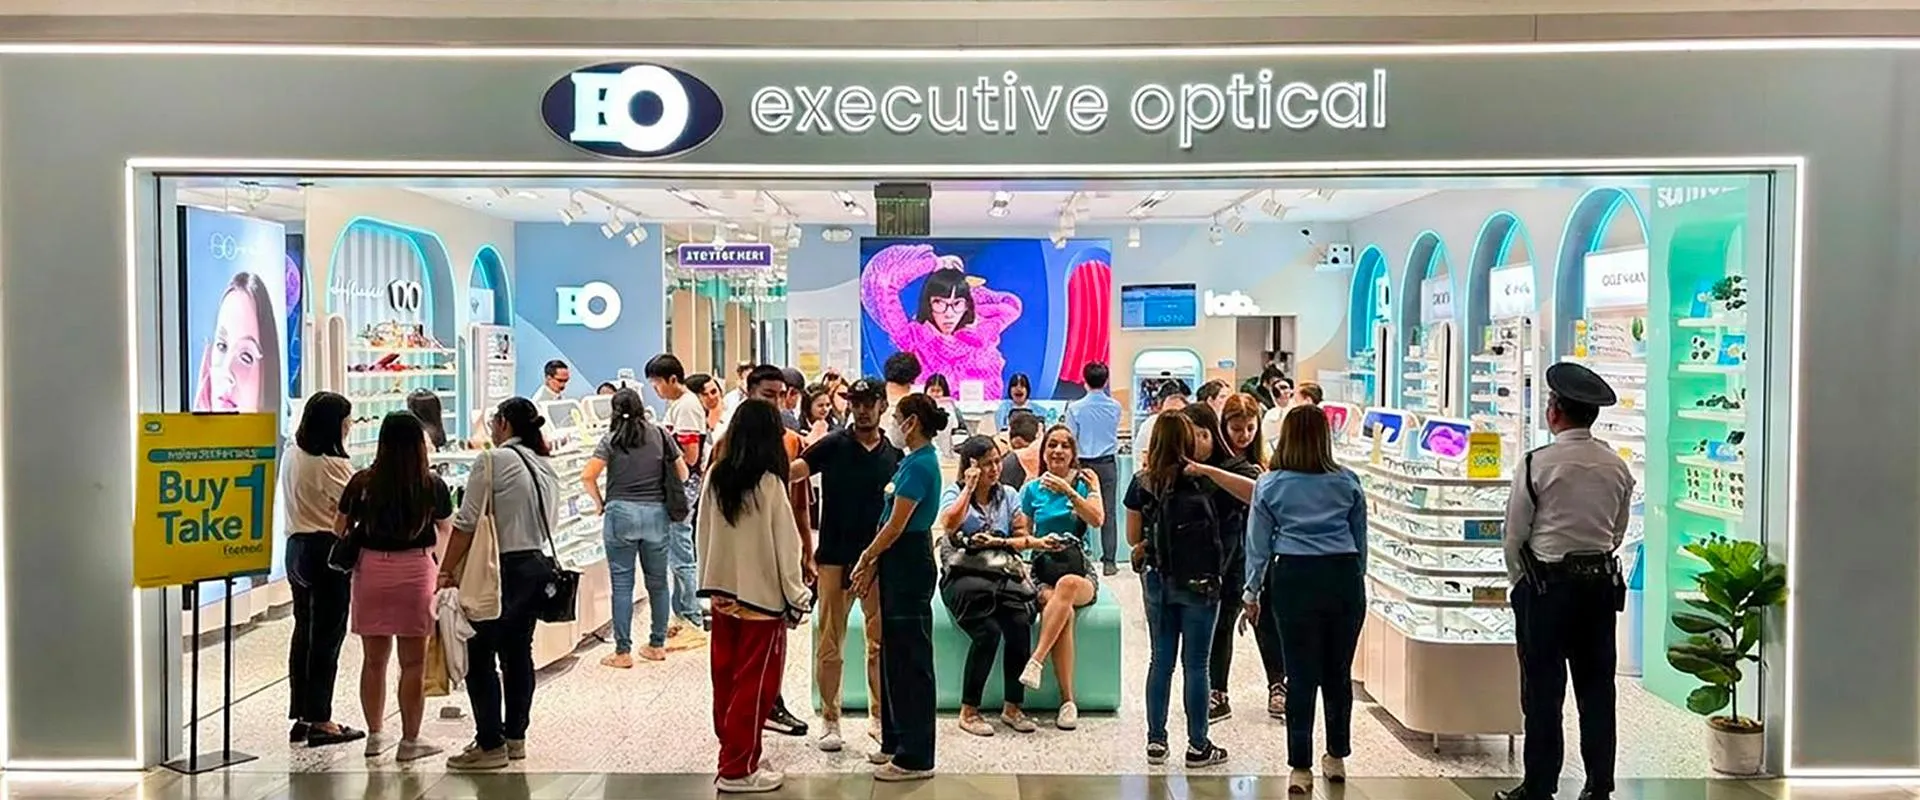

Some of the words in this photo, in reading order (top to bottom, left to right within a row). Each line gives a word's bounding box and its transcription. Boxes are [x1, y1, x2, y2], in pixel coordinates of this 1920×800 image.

[569, 65, 689, 152] EO
[751, 71, 1109, 133] executive
[1131, 69, 1387, 149] optical
[556, 281, 622, 330] EO
[159, 470, 229, 510] Buy
[234, 463, 266, 540] 1
[157, 508, 242, 545] Take
